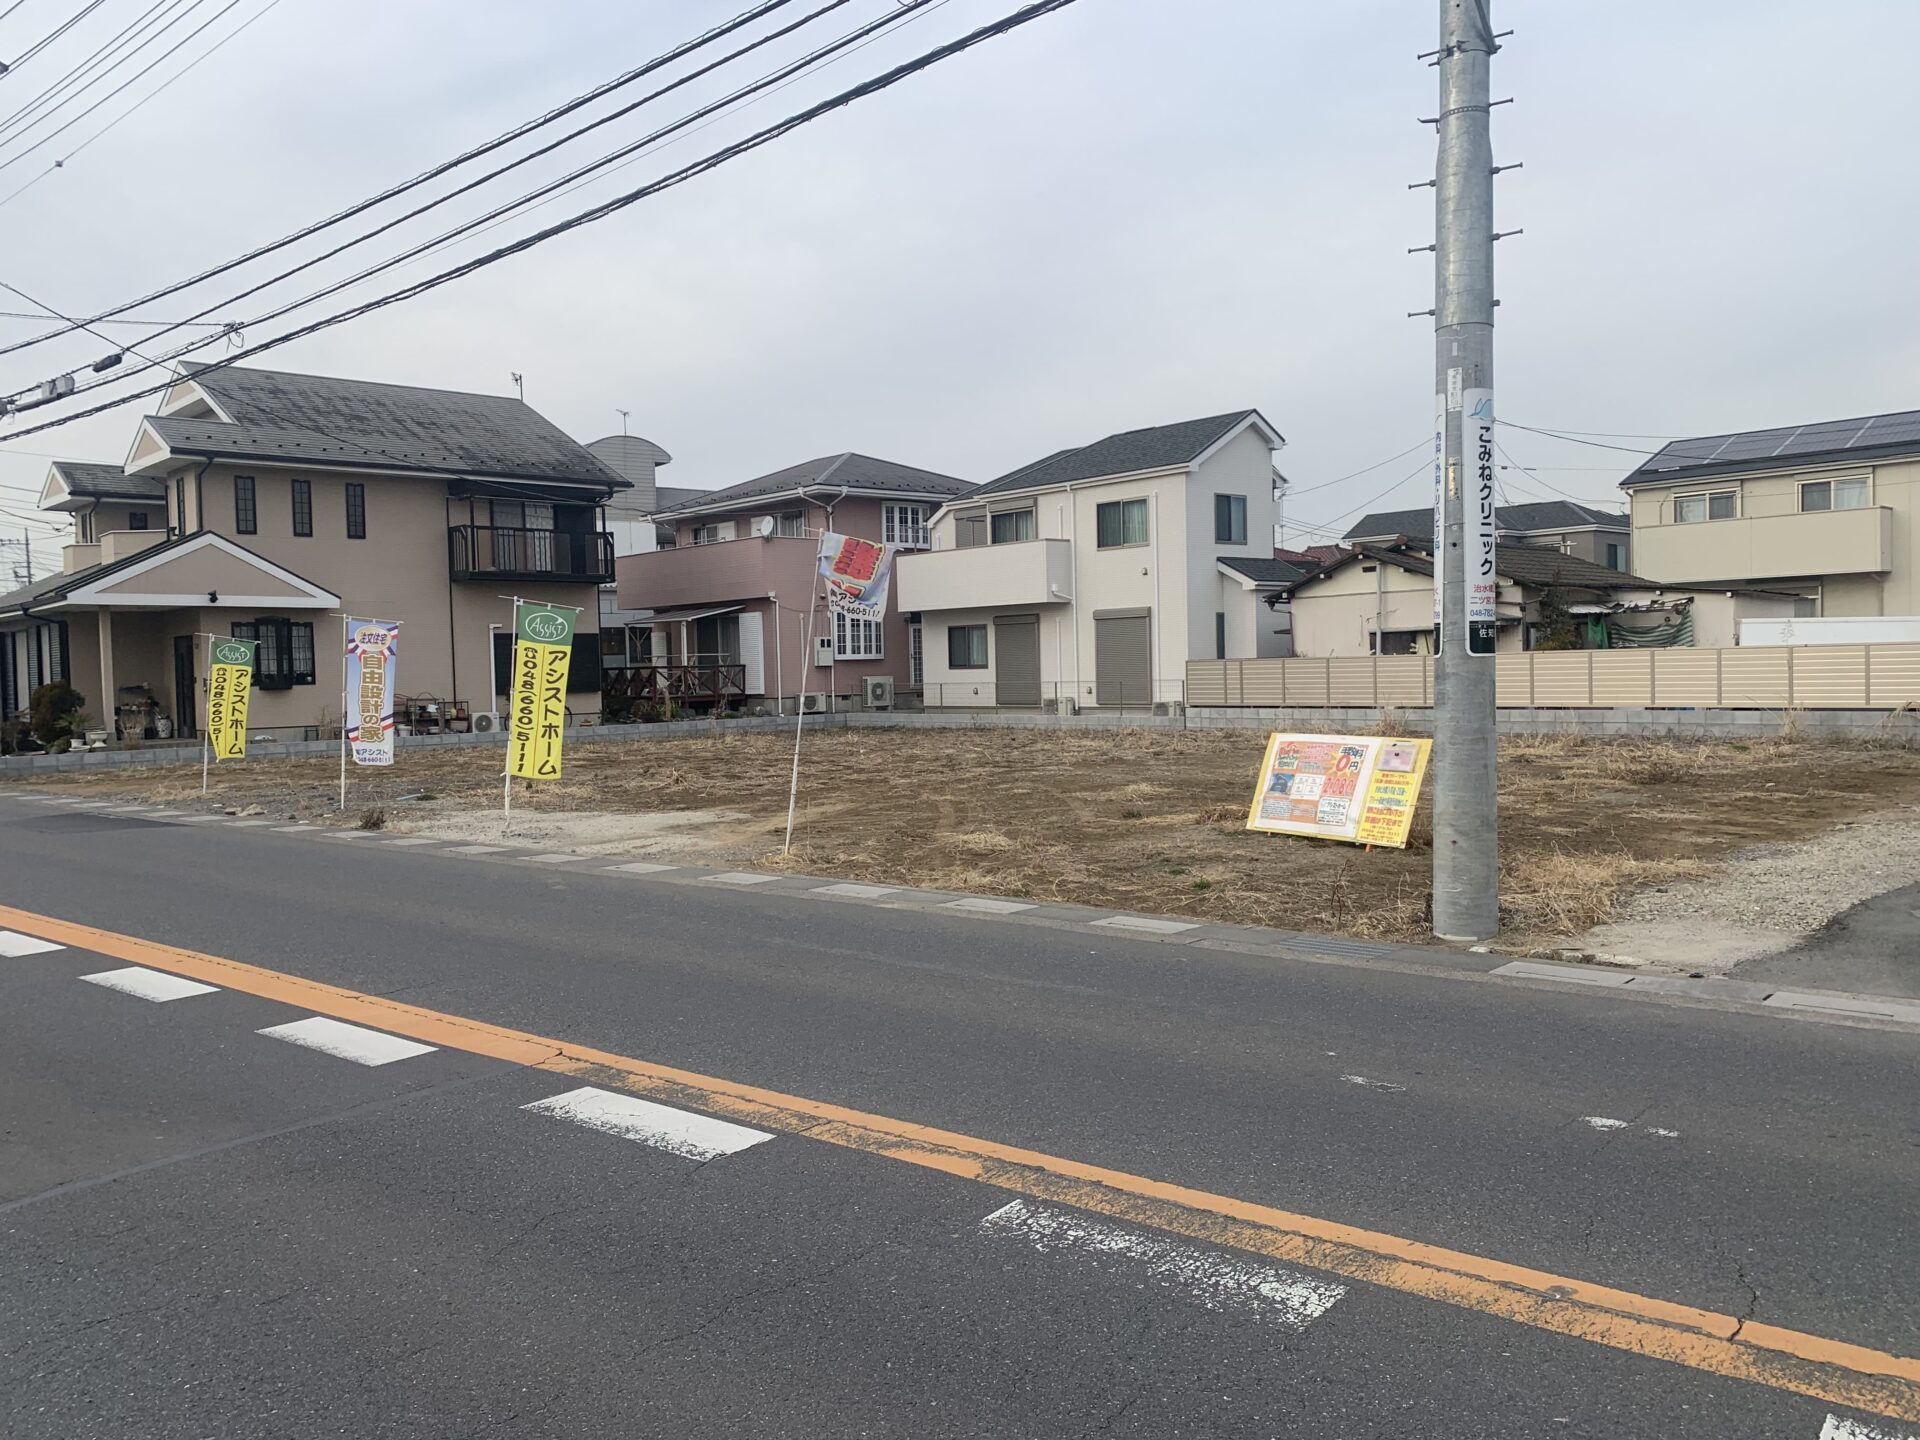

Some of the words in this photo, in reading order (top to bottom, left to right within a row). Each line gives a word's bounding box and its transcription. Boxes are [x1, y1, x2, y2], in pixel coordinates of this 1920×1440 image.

[1478, 426, 1493, 576] こみねクリニック
[359, 632, 388, 645] 注文住宅
[228, 669, 249, 756] アシストホーム
[359, 655, 384, 742] 自由設計の家
[537, 650, 568, 776] アシストホーム
